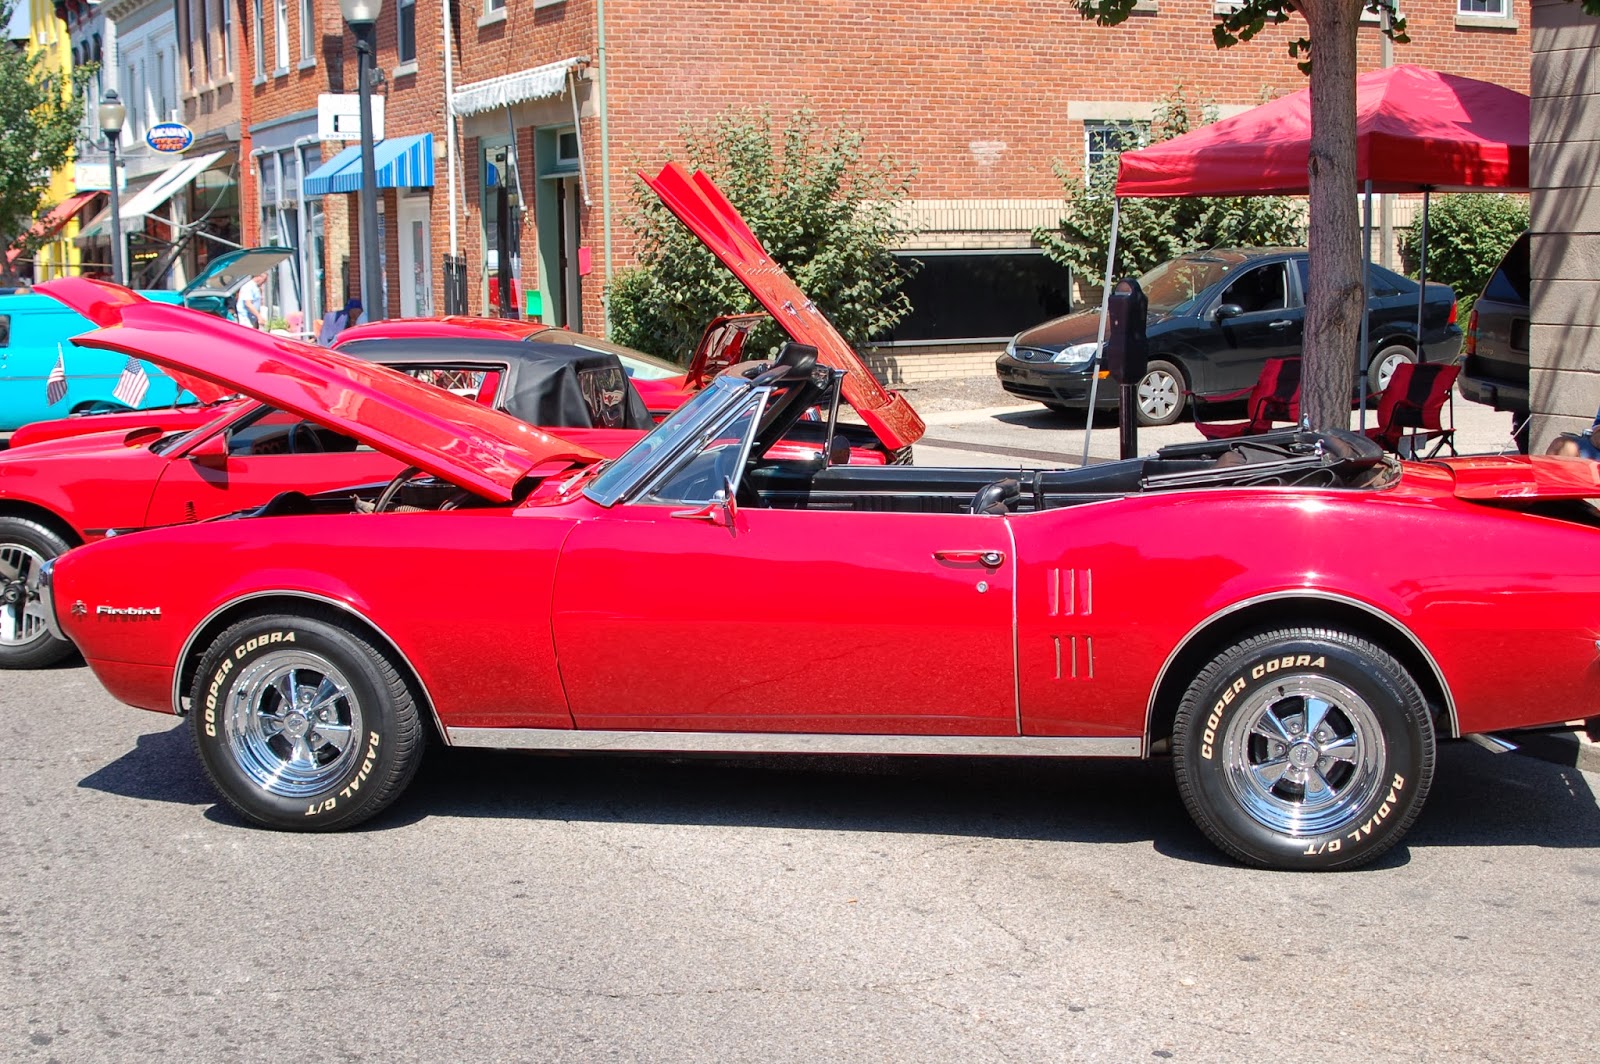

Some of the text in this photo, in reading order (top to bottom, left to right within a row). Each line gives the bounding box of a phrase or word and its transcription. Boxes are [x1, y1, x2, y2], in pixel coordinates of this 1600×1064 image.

[96, 605, 161, 615] Firebird
[205, 631, 296, 737] COOPER COBRA
[1202, 654, 1326, 760] COOPER COBRA
[339, 731, 380, 799] RADIAL
[1347, 772, 1405, 842] RADIAL
